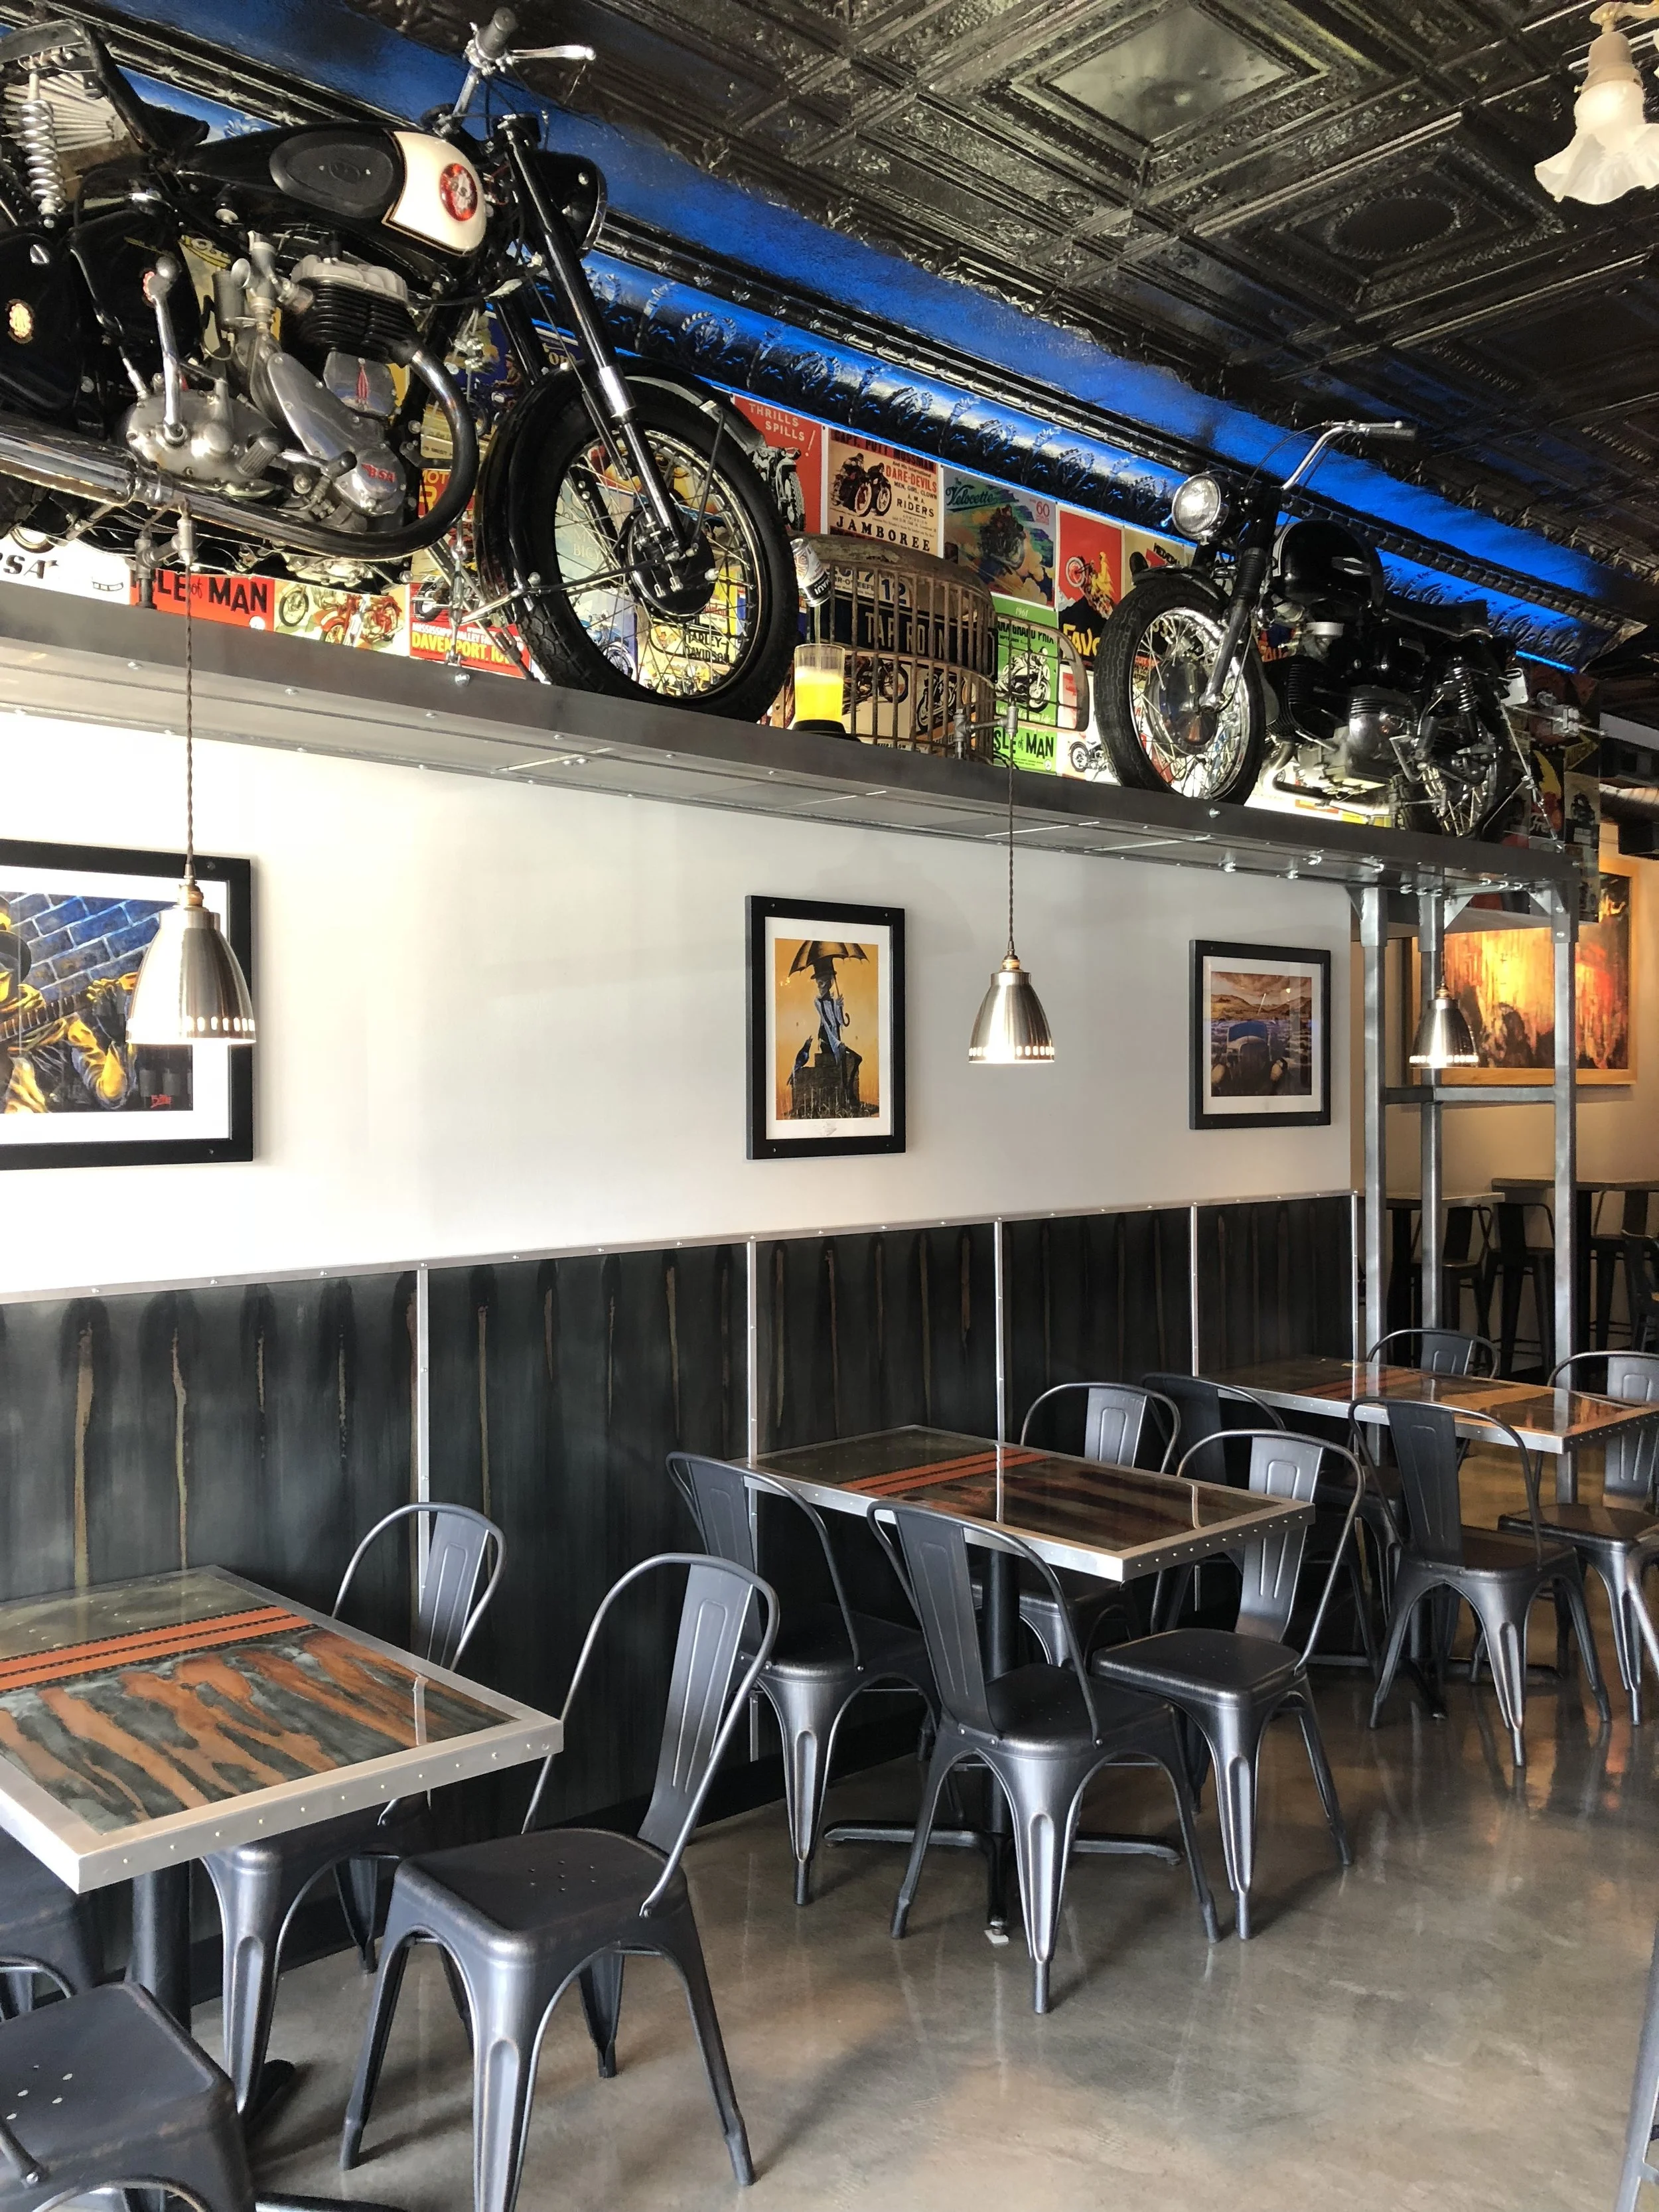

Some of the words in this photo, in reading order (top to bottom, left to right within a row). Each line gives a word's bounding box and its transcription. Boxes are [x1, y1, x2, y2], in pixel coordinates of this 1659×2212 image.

[749, 403, 799, 427] THRILLS
[765, 420, 805, 441] SPILLS
[361, 463, 396, 483] BSA
[886, 465, 937, 493] DARE-DEVILS
[920, 490, 937, 500] CLOWN
[946, 484, 994, 508] Velocette
[897, 498, 934, 518] RIDERS
[1036, 501, 1050, 517] 60
[836, 516, 930, 552] JAMBOREE
[0, 552, 46, 579] SA
[208, 576, 267, 615] MAN
[1015, 607, 1029, 617] 1961
[993, 729, 1017, 754] SLE
[1026, 732, 1054, 759] MAN
